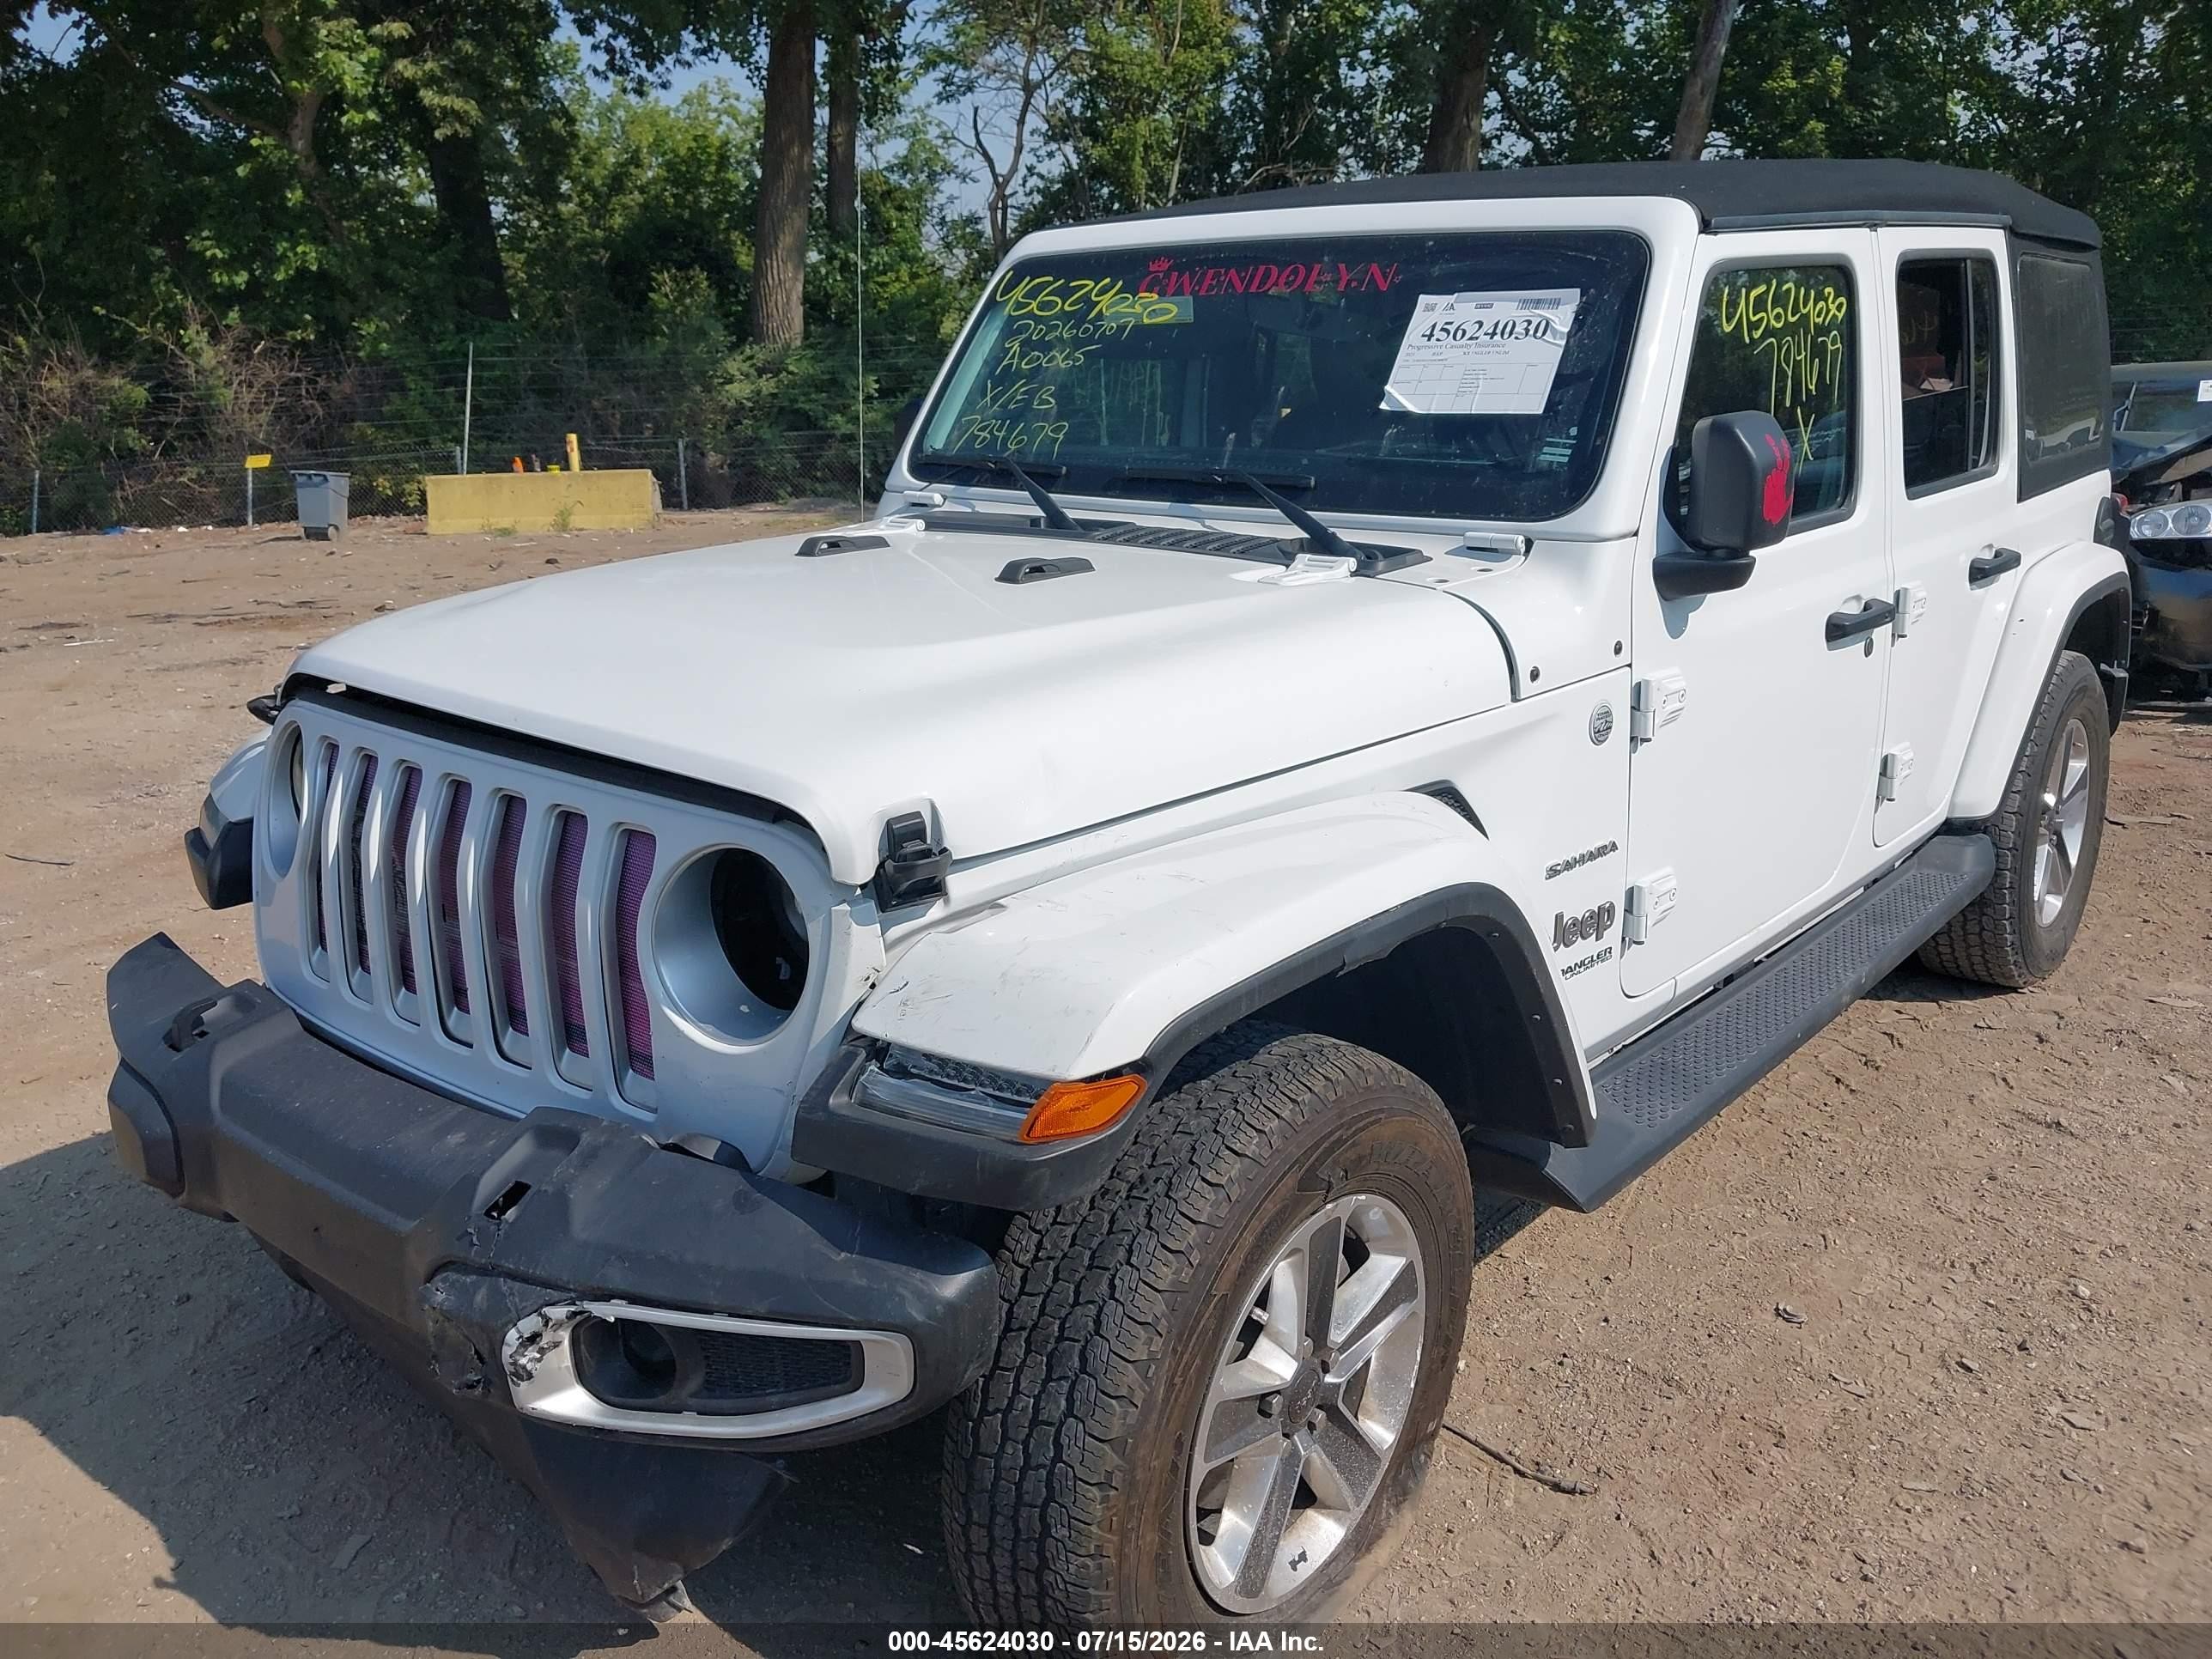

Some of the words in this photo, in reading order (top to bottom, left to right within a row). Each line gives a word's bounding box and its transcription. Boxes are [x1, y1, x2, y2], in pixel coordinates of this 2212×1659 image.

[1139, 261, 1398, 297] GWENDOLYN
[1723, 278, 1847, 343] 45624030
[1005, 318, 1134, 348] 20260707
[1421, 318, 1550, 342] 45624030
[995, 344, 1103, 375] A0065
[1753, 328, 1843, 416] 784679
[952, 416, 1069, 459] 784679
[1545, 840, 1619, 880] SAHARA
[1552, 901, 1616, 953] Jeep
[1565, 954, 1613, 981] UNLIMITED
